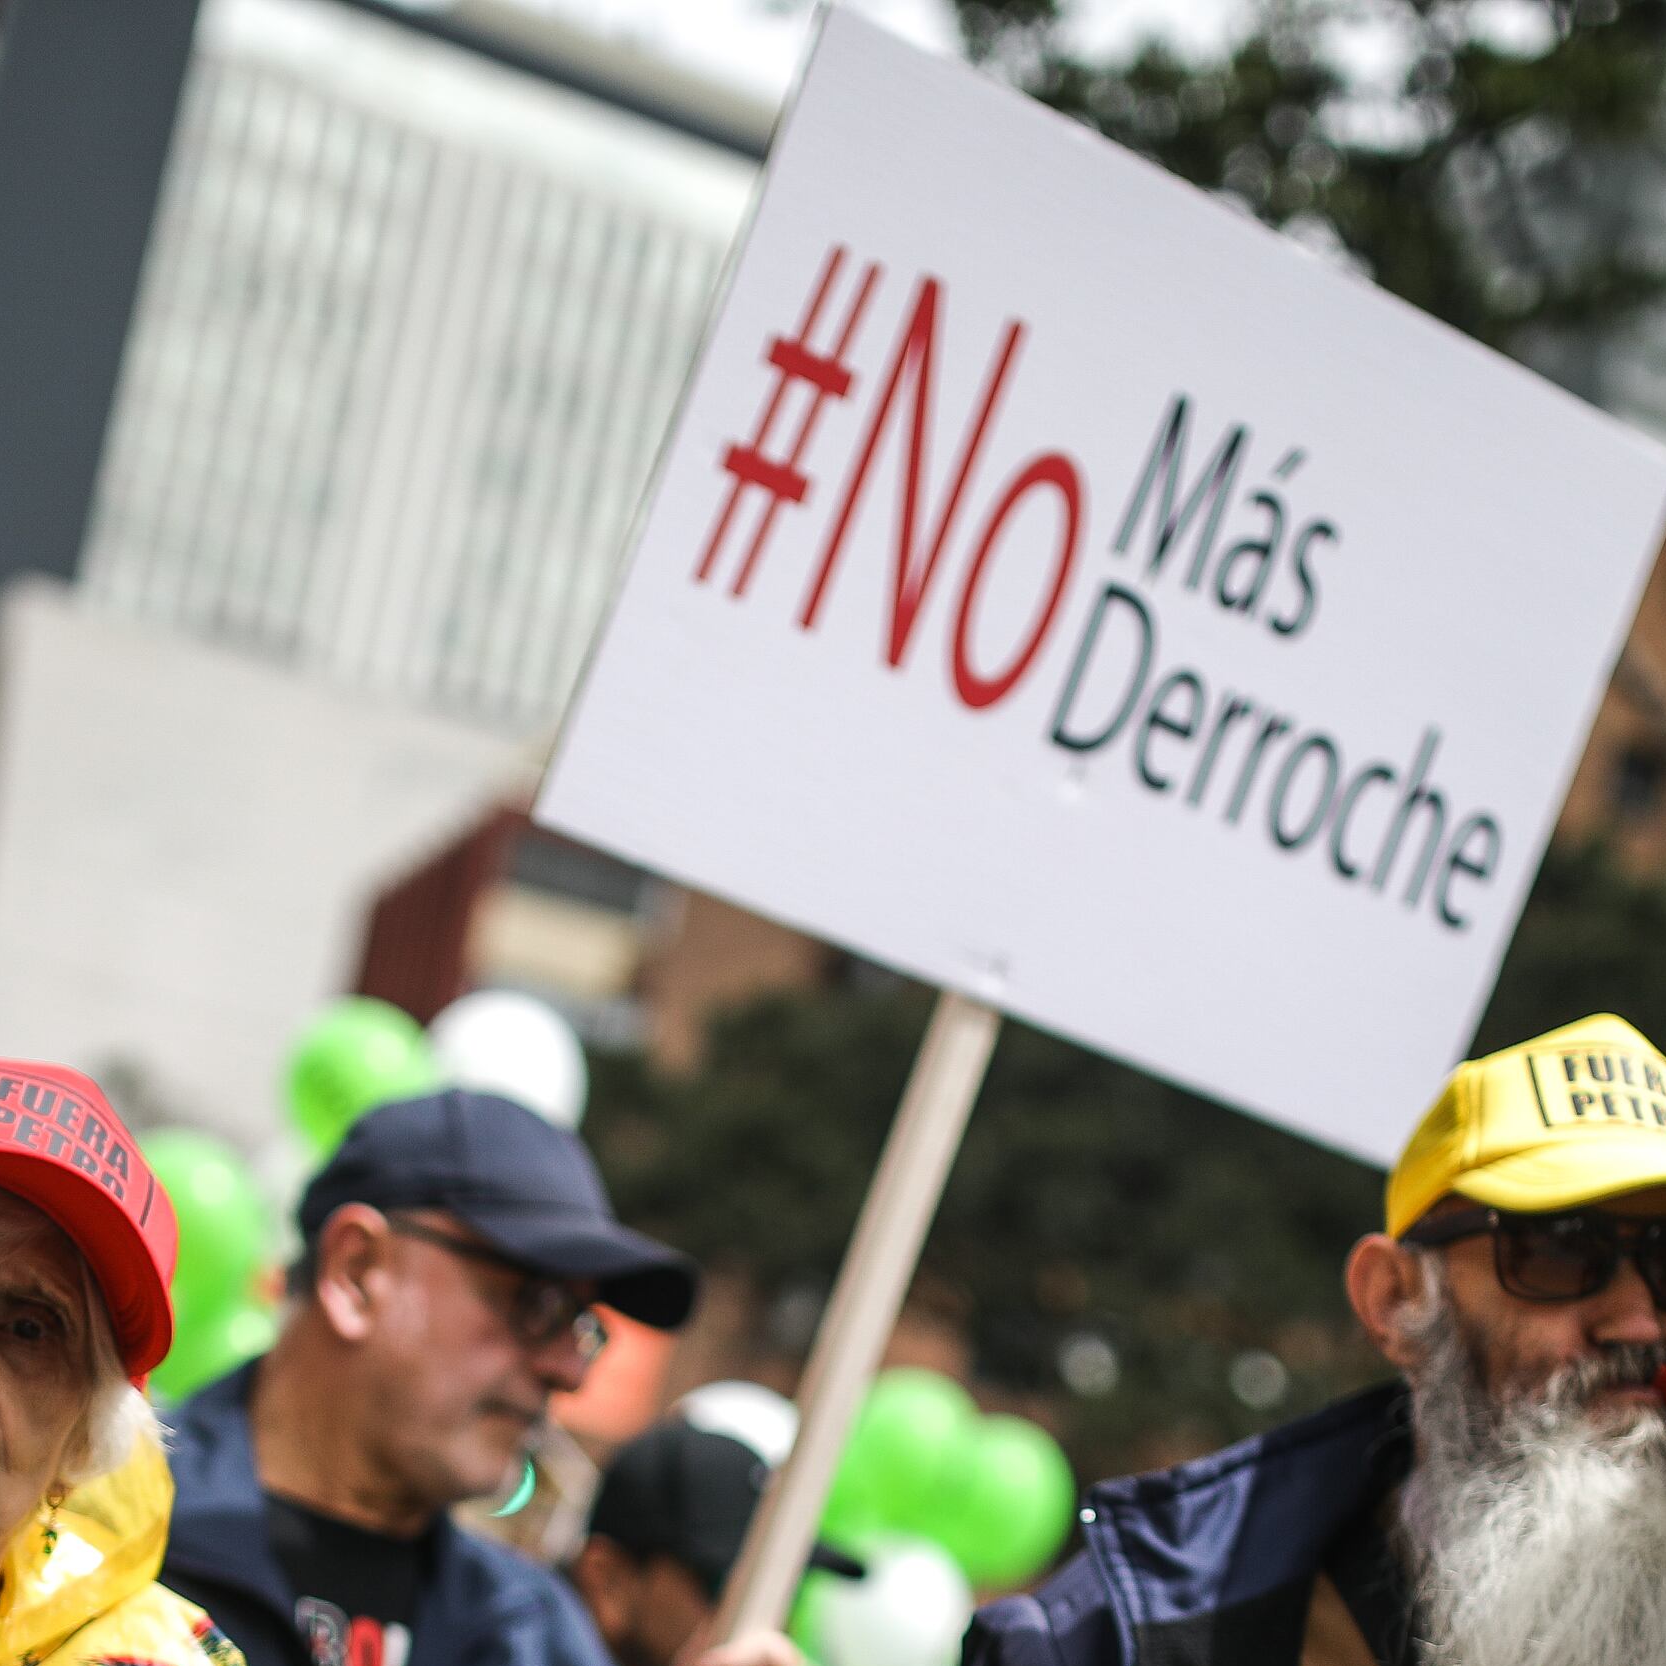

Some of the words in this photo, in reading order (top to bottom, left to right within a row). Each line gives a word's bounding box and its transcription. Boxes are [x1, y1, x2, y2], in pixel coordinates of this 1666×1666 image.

[691, 244, 1085, 713] #No
[1110, 391, 1342, 641] Más
[1043, 577, 1505, 934] Derroche
